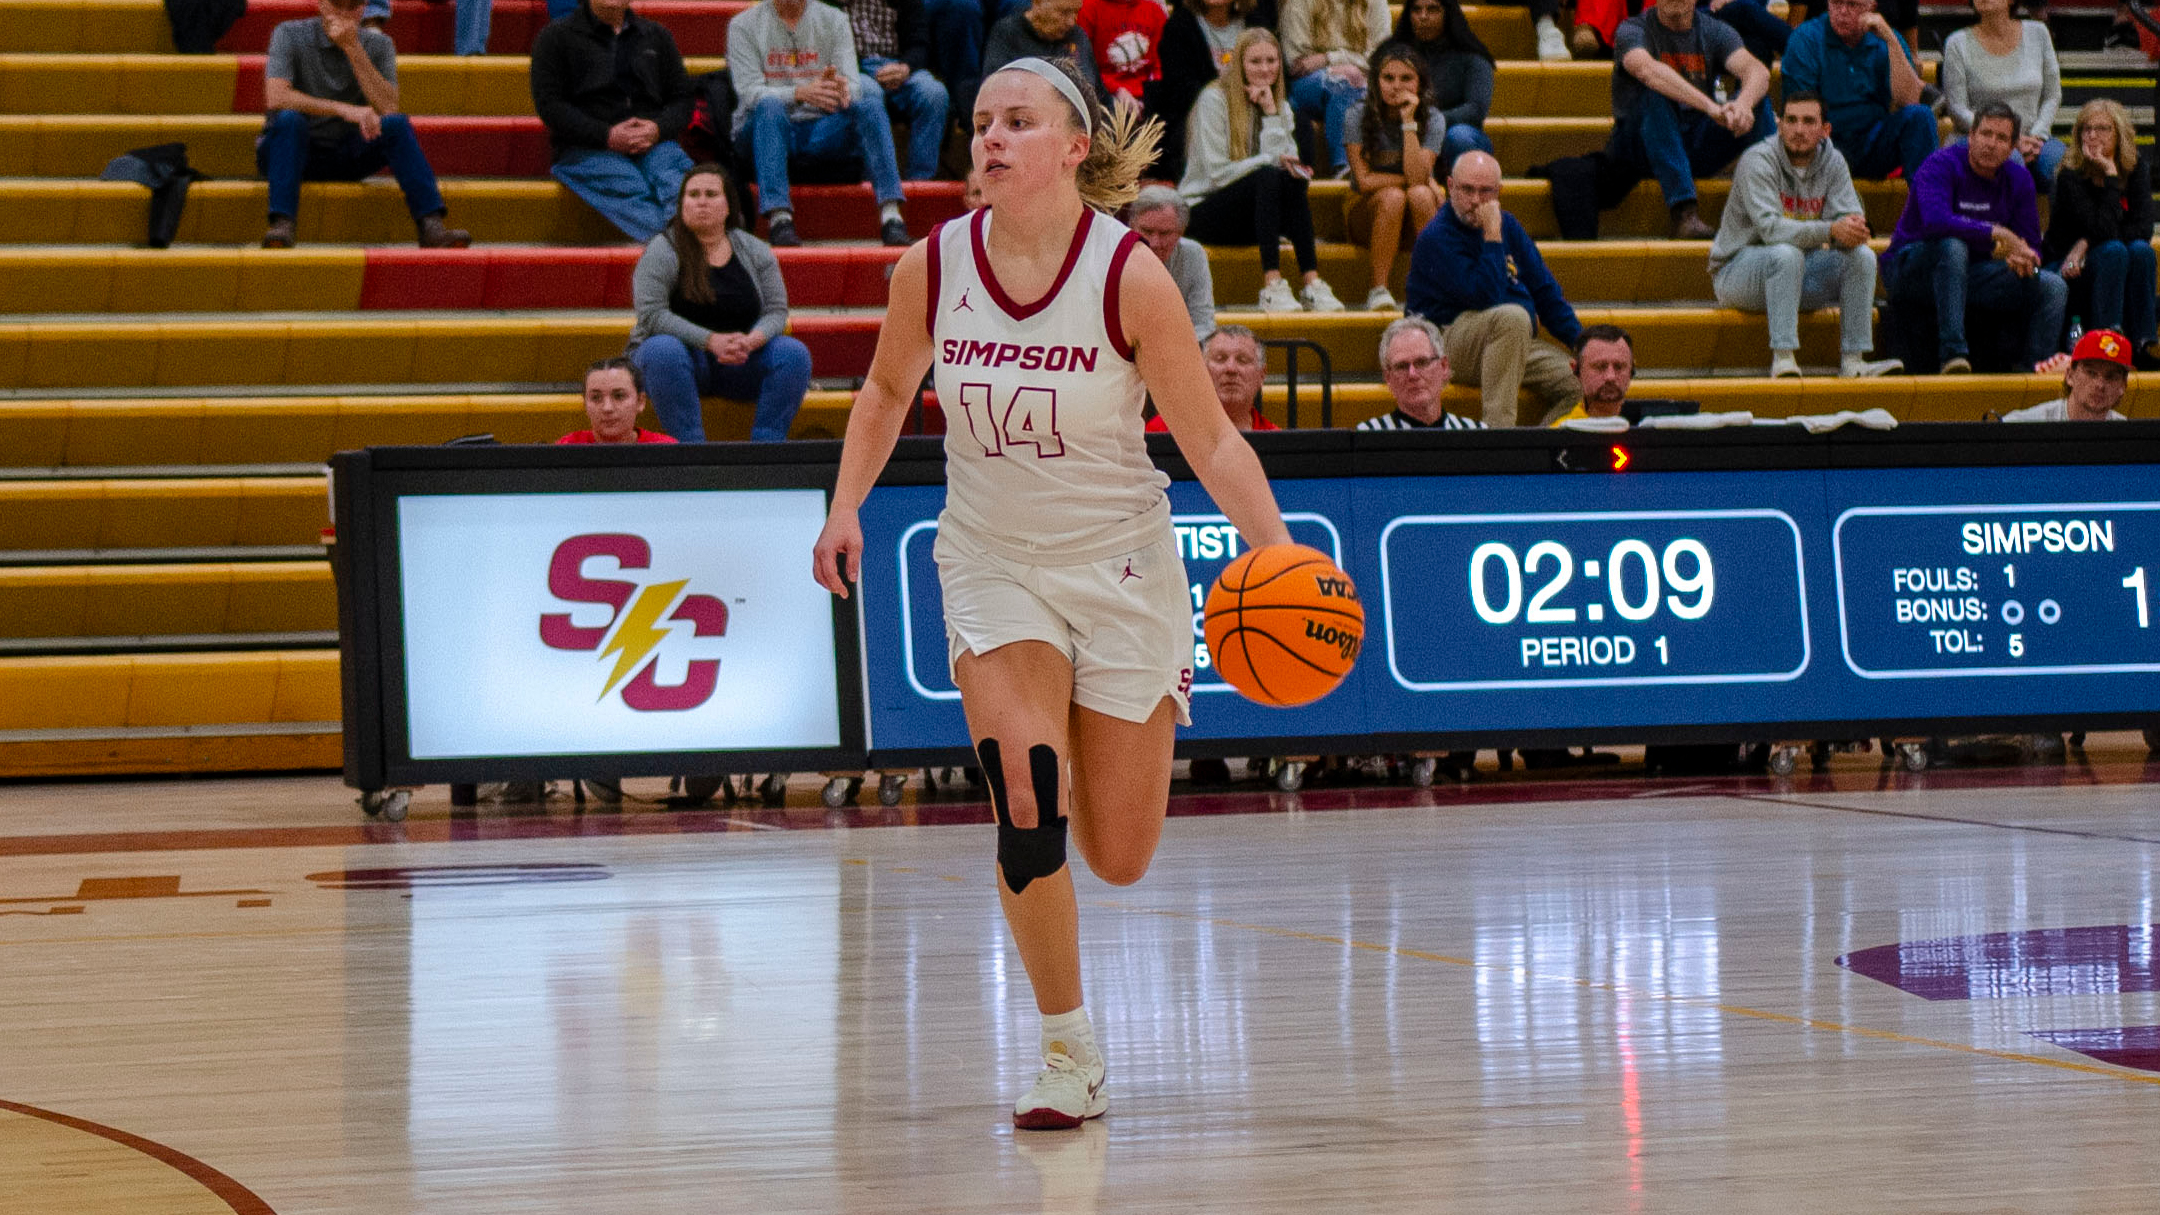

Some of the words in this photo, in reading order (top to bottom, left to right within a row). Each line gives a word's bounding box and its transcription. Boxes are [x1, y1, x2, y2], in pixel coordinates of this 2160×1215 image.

[943, 339, 1099, 372] SIMPSON
[960, 382, 1065, 458] 14
[1174, 525, 1239, 560] TIST
[1962, 520, 2115, 555] SIMPSON
[1316, 576, 1359, 600] CAA
[1469, 538, 1715, 625] 02:09
[1893, 566, 1978, 592] FOULS:
[2003, 563, 2016, 588] 1
[1191, 582, 1204, 608] 1
[1896, 596, 1988, 623] BONUS:
[1194, 642, 1212, 669] 5
[1521, 636, 1636, 667] PERIOD
[1655, 635, 1669, 665] 1
[1930, 629, 1984, 653] TOL:
[2008, 633, 2024, 658] 5
